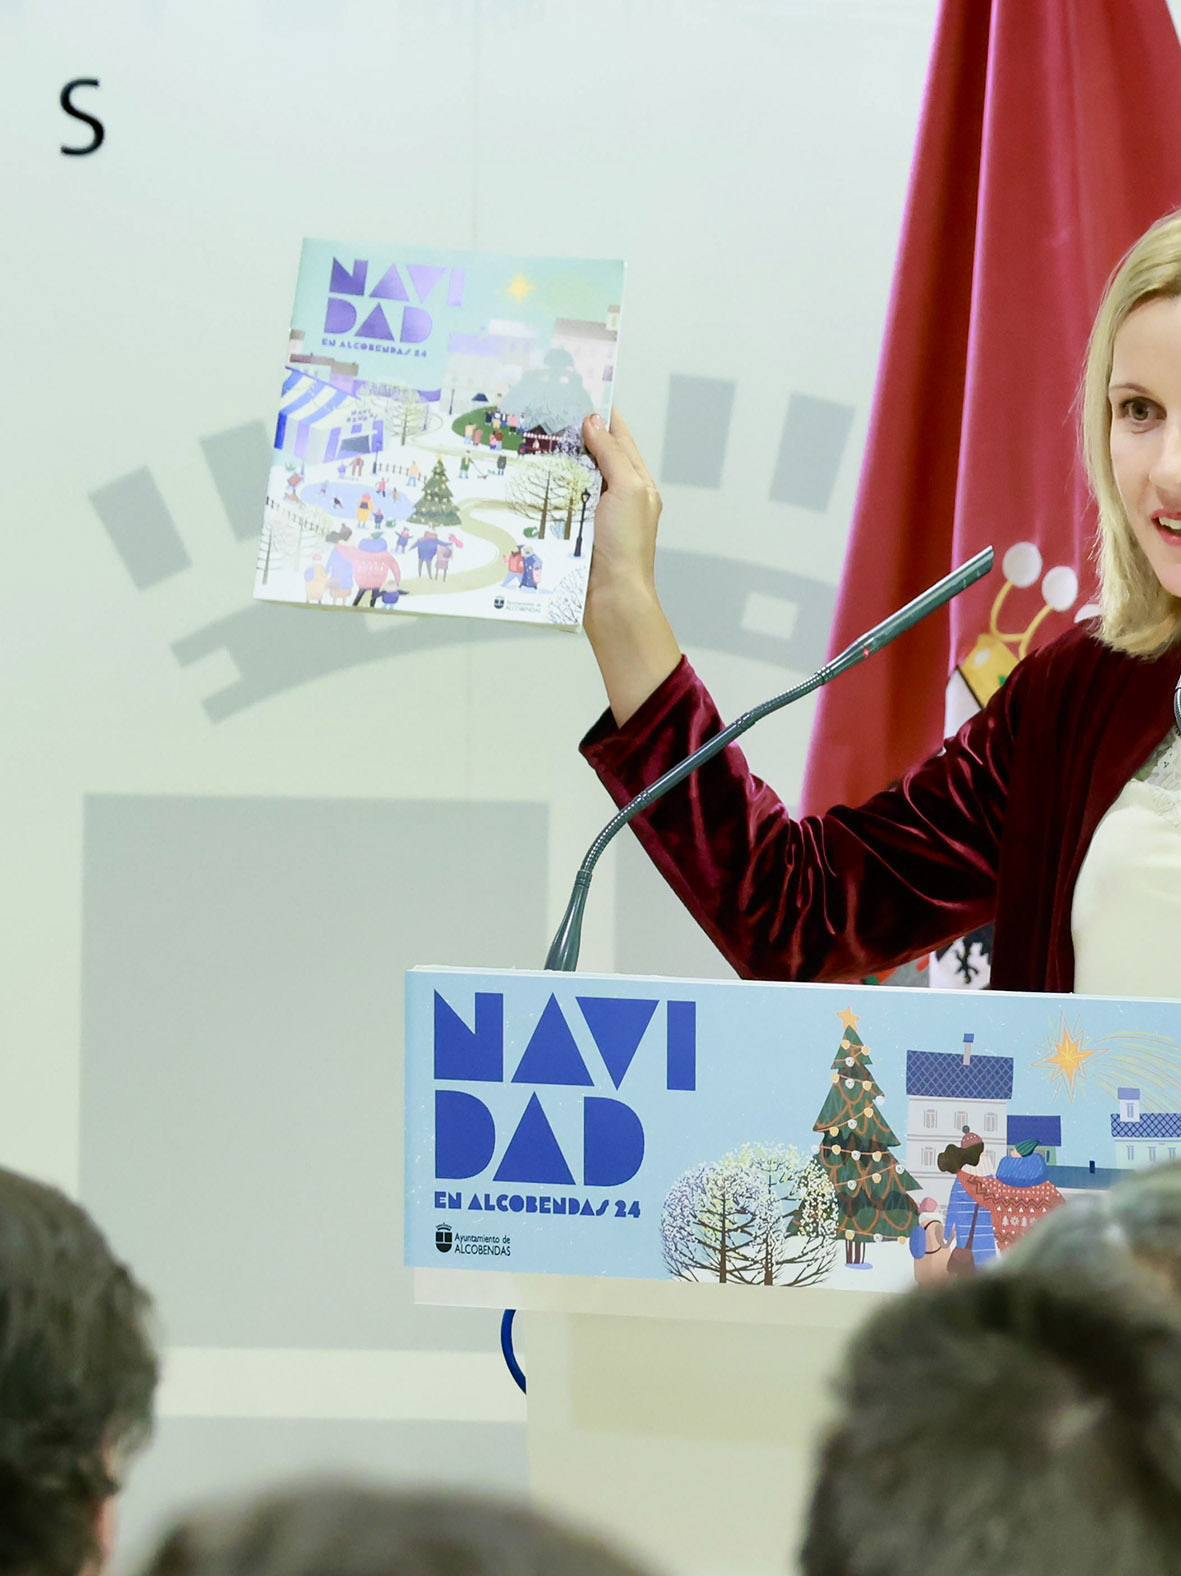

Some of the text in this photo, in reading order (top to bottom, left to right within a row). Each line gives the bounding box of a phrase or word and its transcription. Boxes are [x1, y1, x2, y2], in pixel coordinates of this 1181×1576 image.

[59, 78, 105, 156] S
[329, 256, 466, 307] NAVI
[323, 296, 433, 344] DAD
[321, 338, 427, 358] EN ALCOBENDAS 24
[434, 989, 696, 1090] NAVI
[434, 1089, 645, 1187] DAD
[434, 1191, 641, 1219] EN ALCOBENDAS 24
[454, 1232, 511, 1244] Ayuntamiento de
[454, 1244, 511, 1257] ALCOBENDAS
